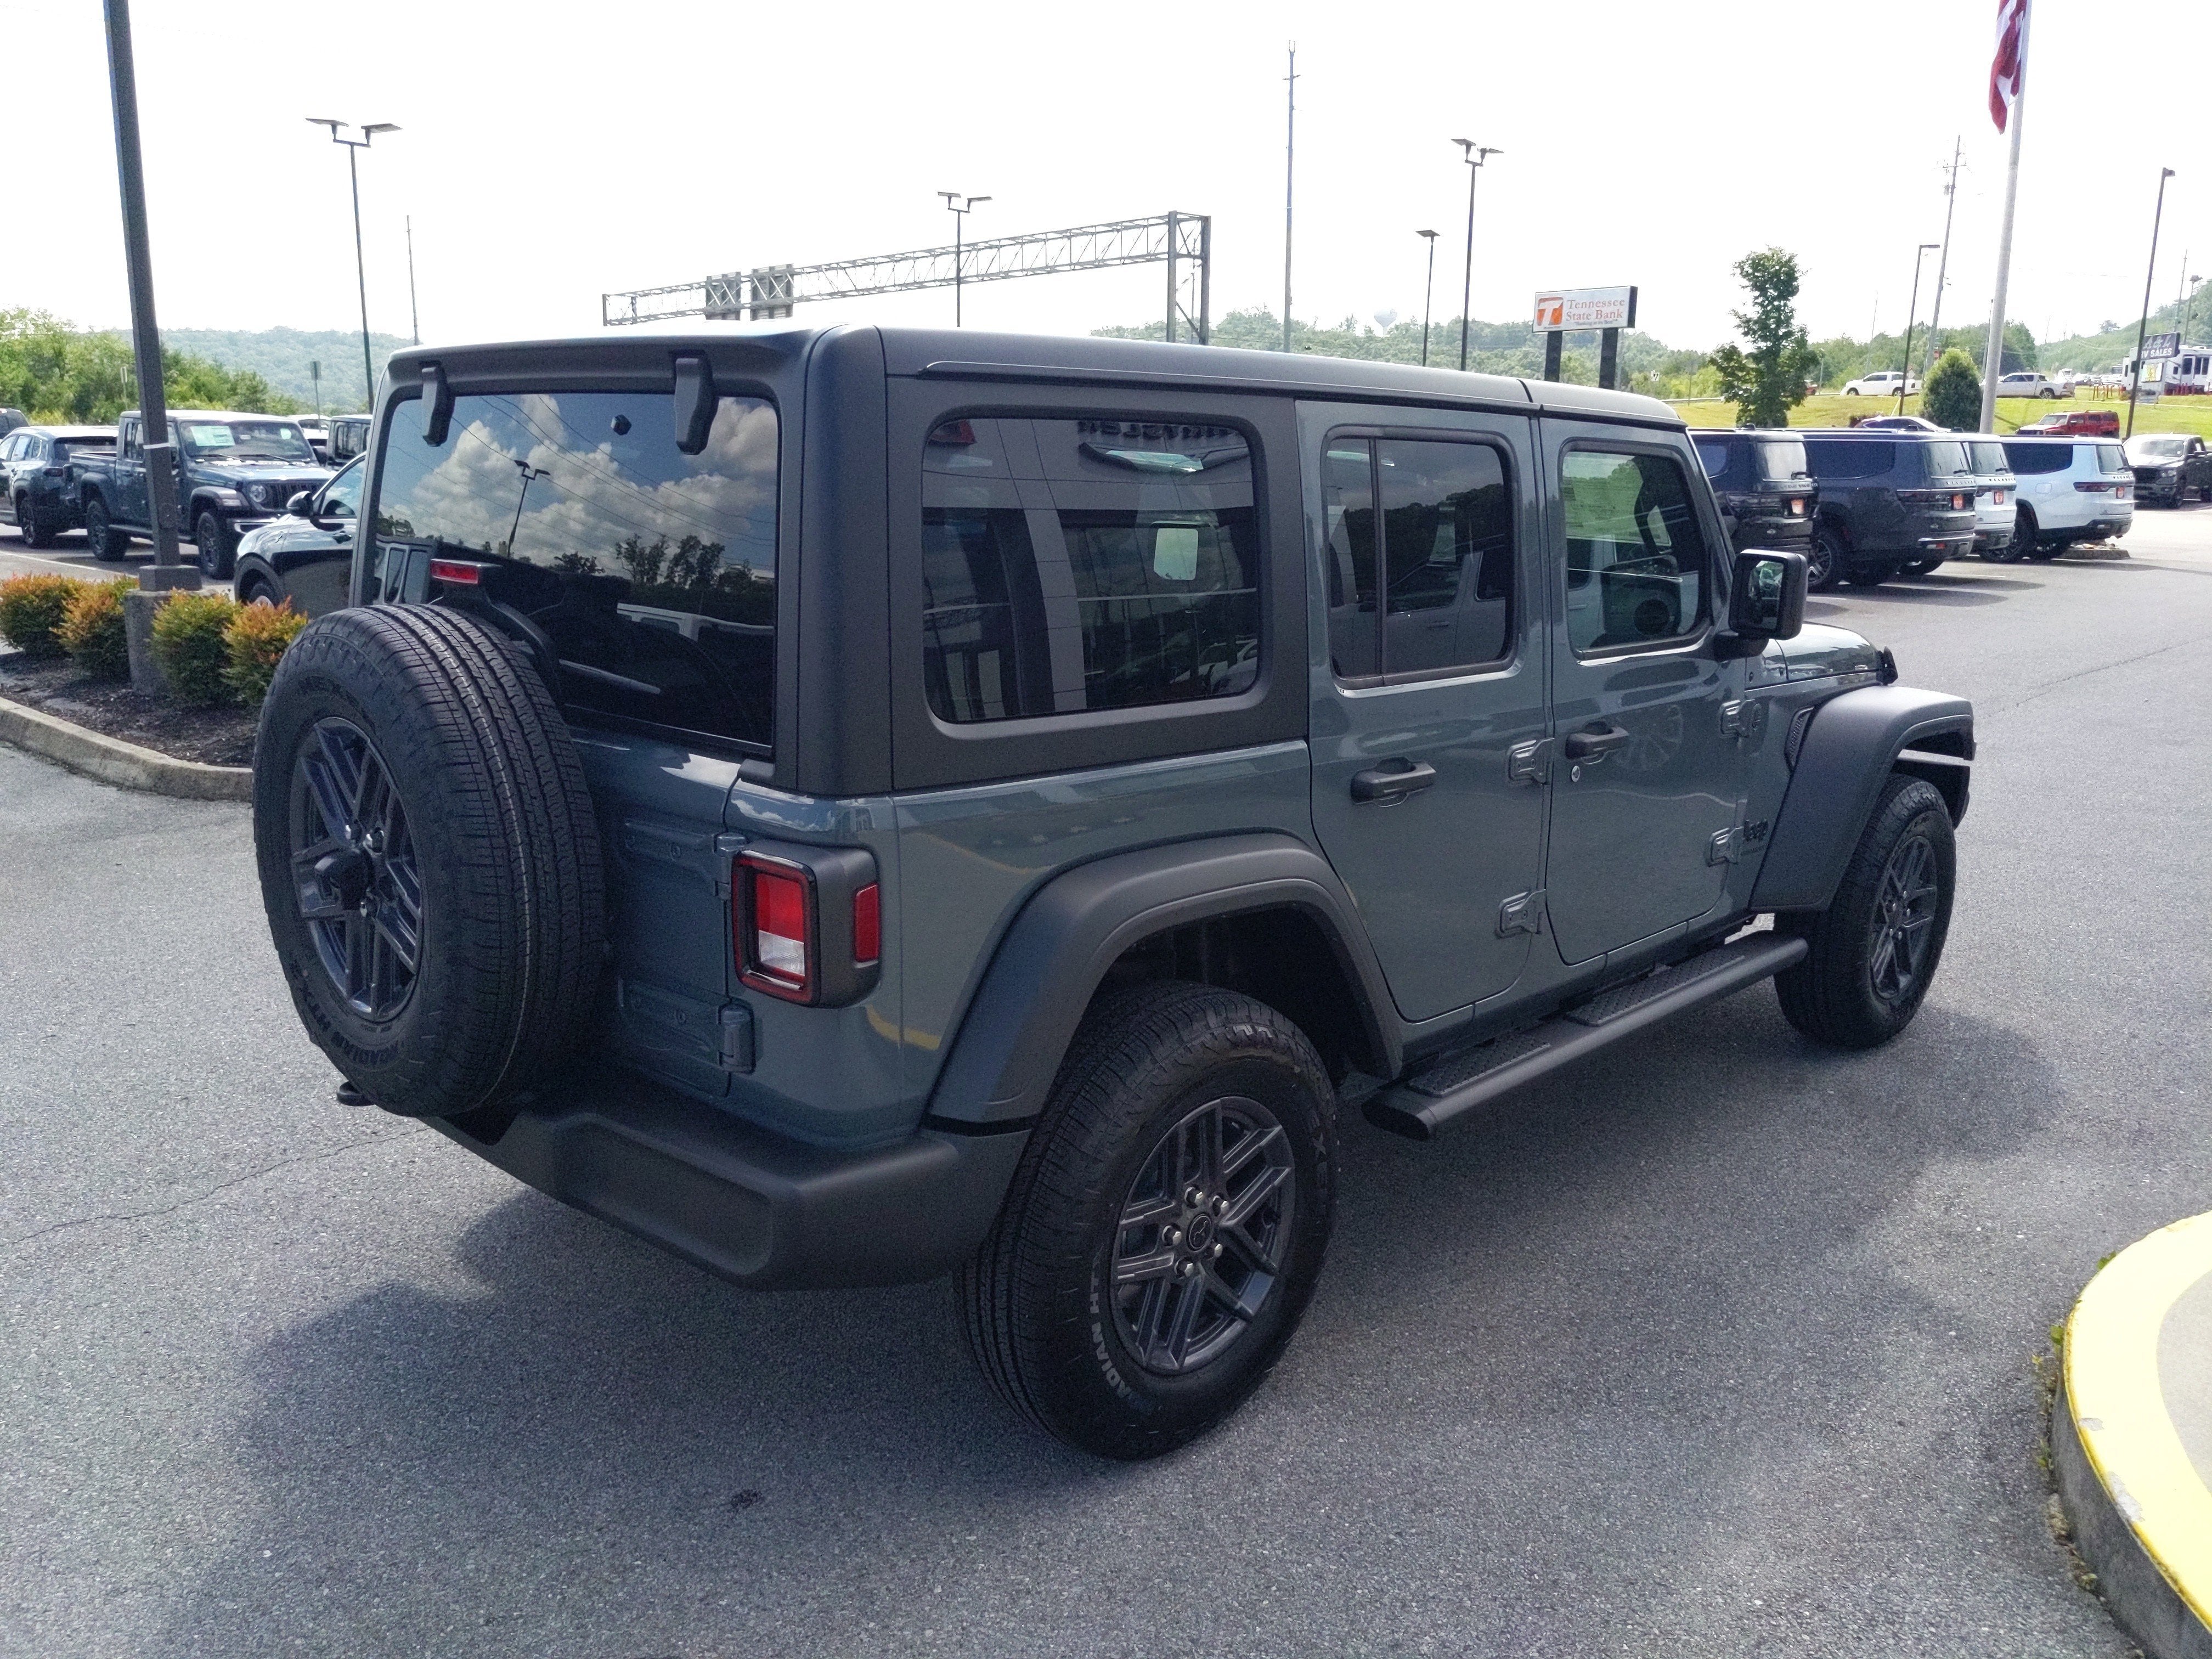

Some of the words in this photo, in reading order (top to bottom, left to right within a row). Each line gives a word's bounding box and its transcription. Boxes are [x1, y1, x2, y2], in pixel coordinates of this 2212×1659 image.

[1567, 300, 1625, 309] Tennessee
[1566, 311, 1591, 321] State
[1595, 309, 1623, 319] Bank
[2151, 348, 2172, 357] SALES
